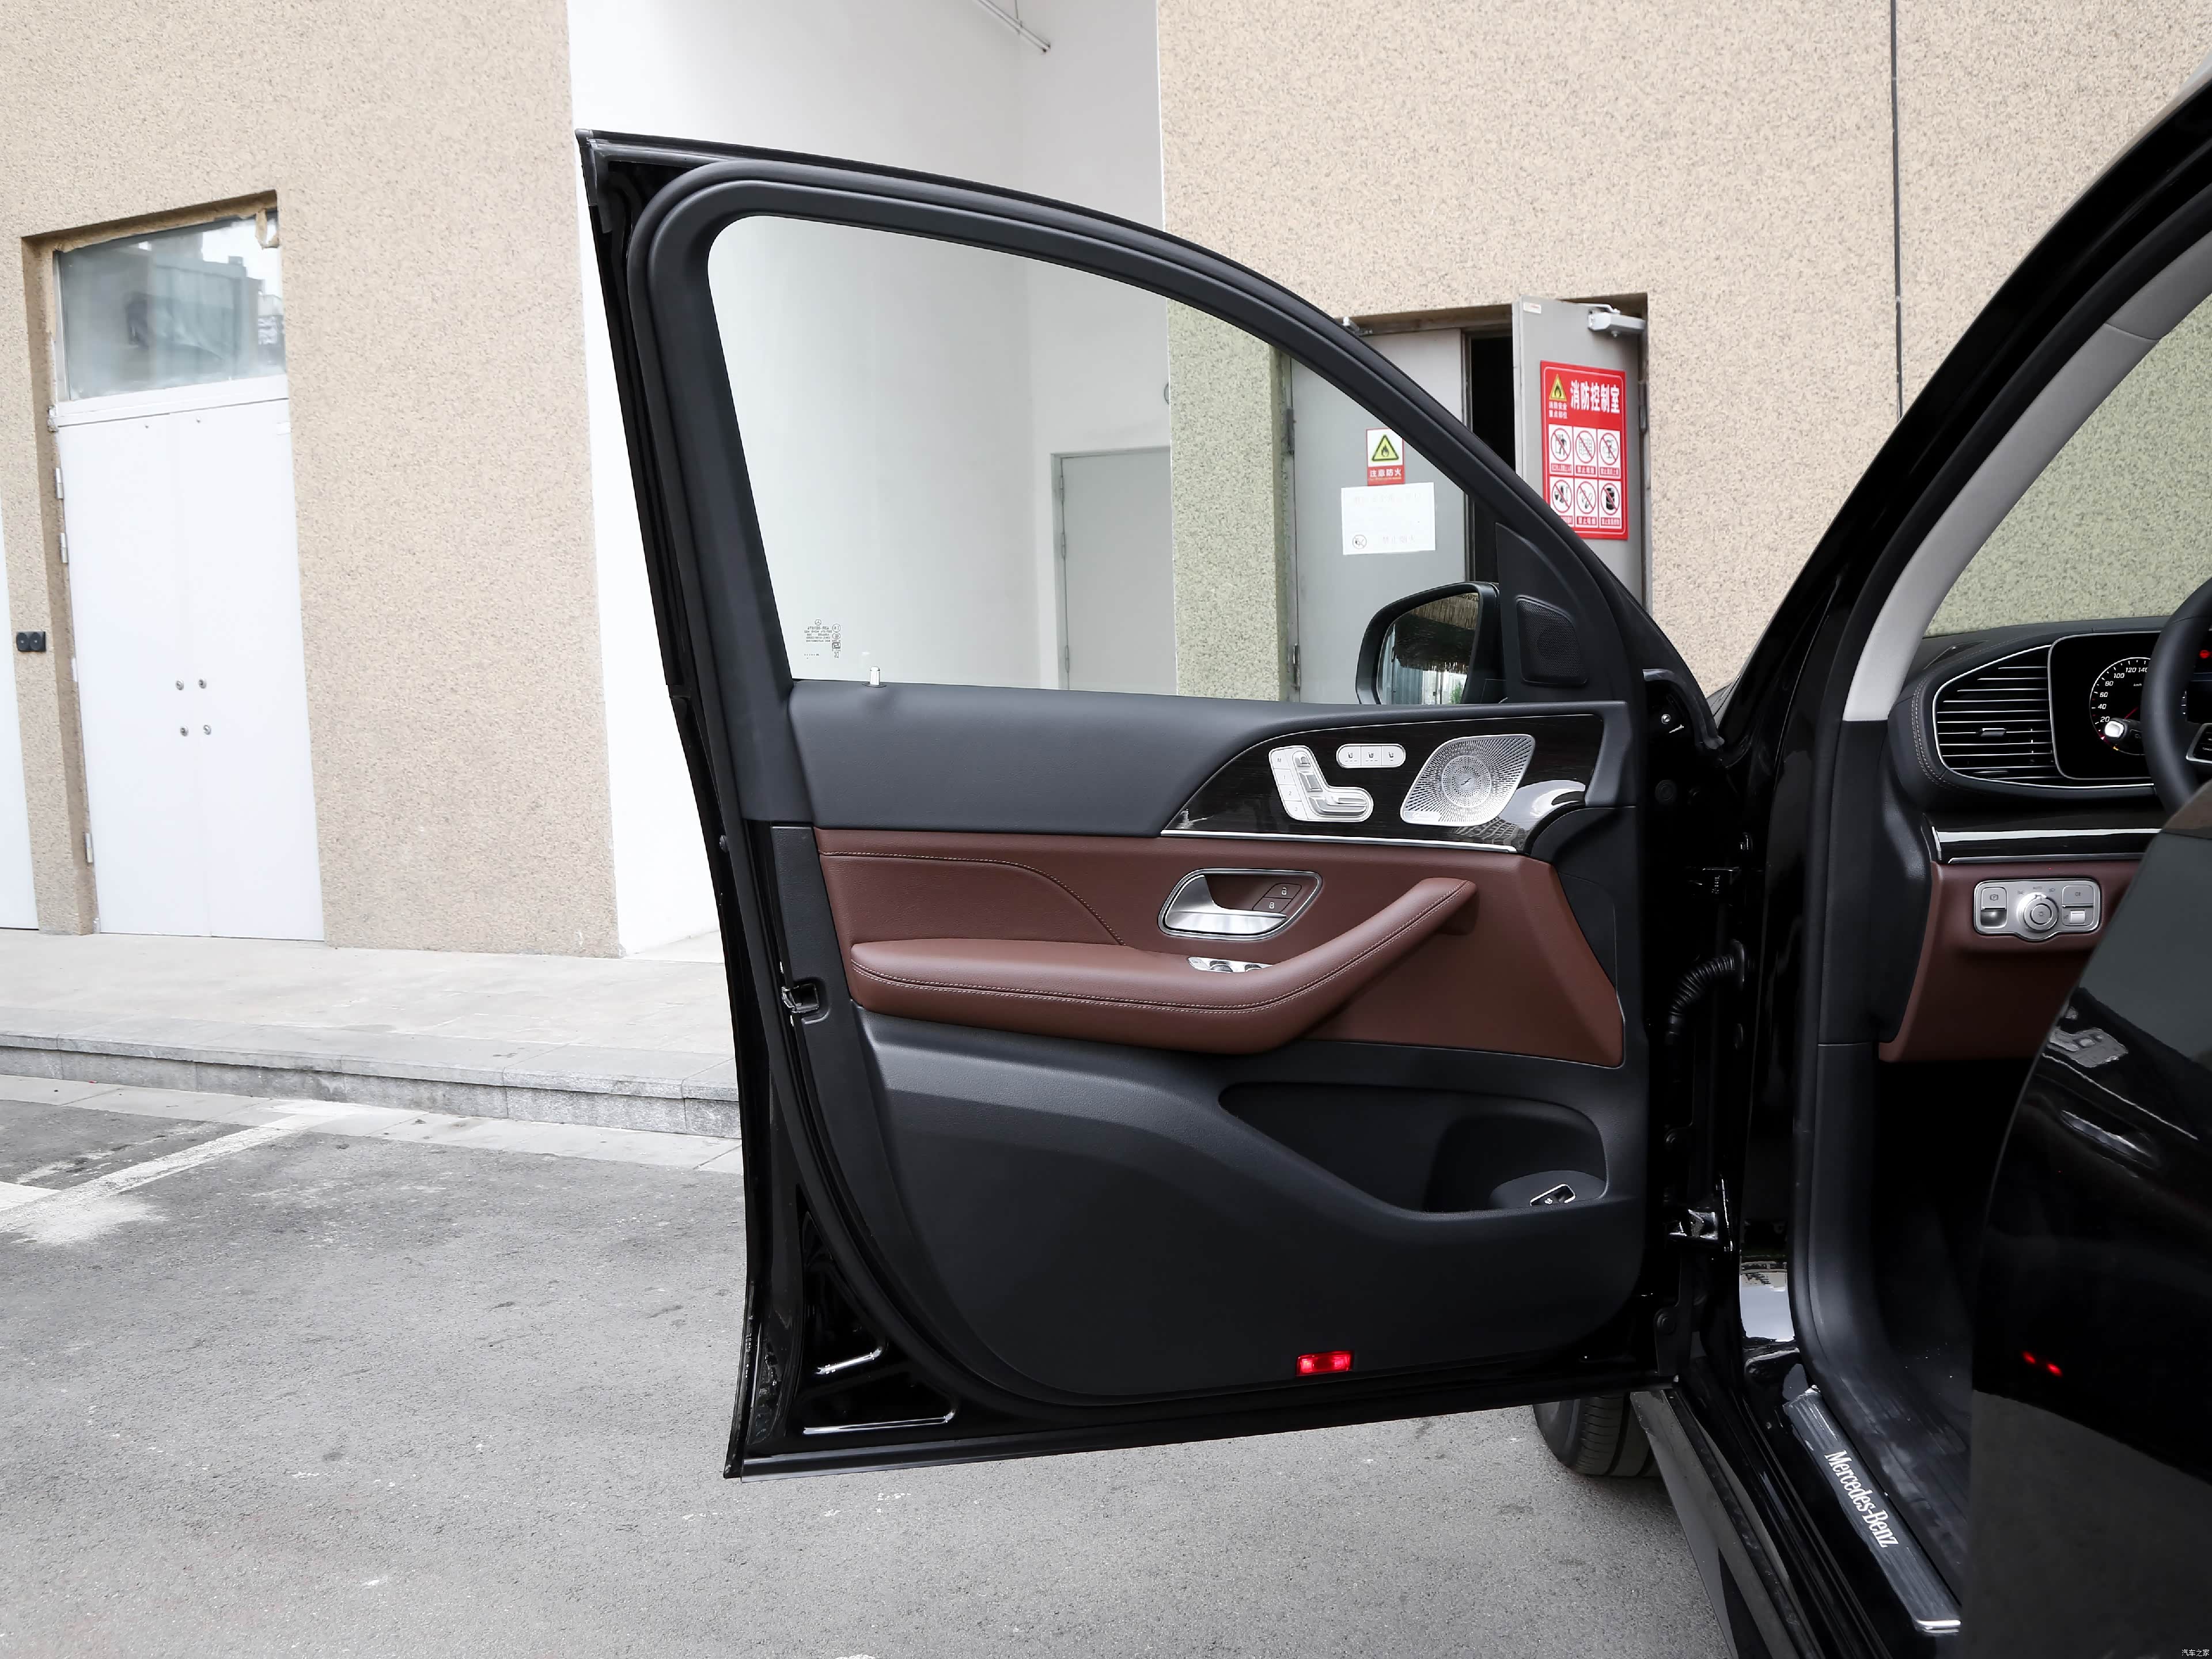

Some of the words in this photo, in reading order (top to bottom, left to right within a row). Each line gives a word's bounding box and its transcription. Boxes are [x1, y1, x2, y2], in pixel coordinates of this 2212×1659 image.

[1570, 379, 1620, 414] 消防控制室
[1370, 468, 1402, 478] 注意防火
[1824, 1449, 1899, 1548] Mercedes-Benz
